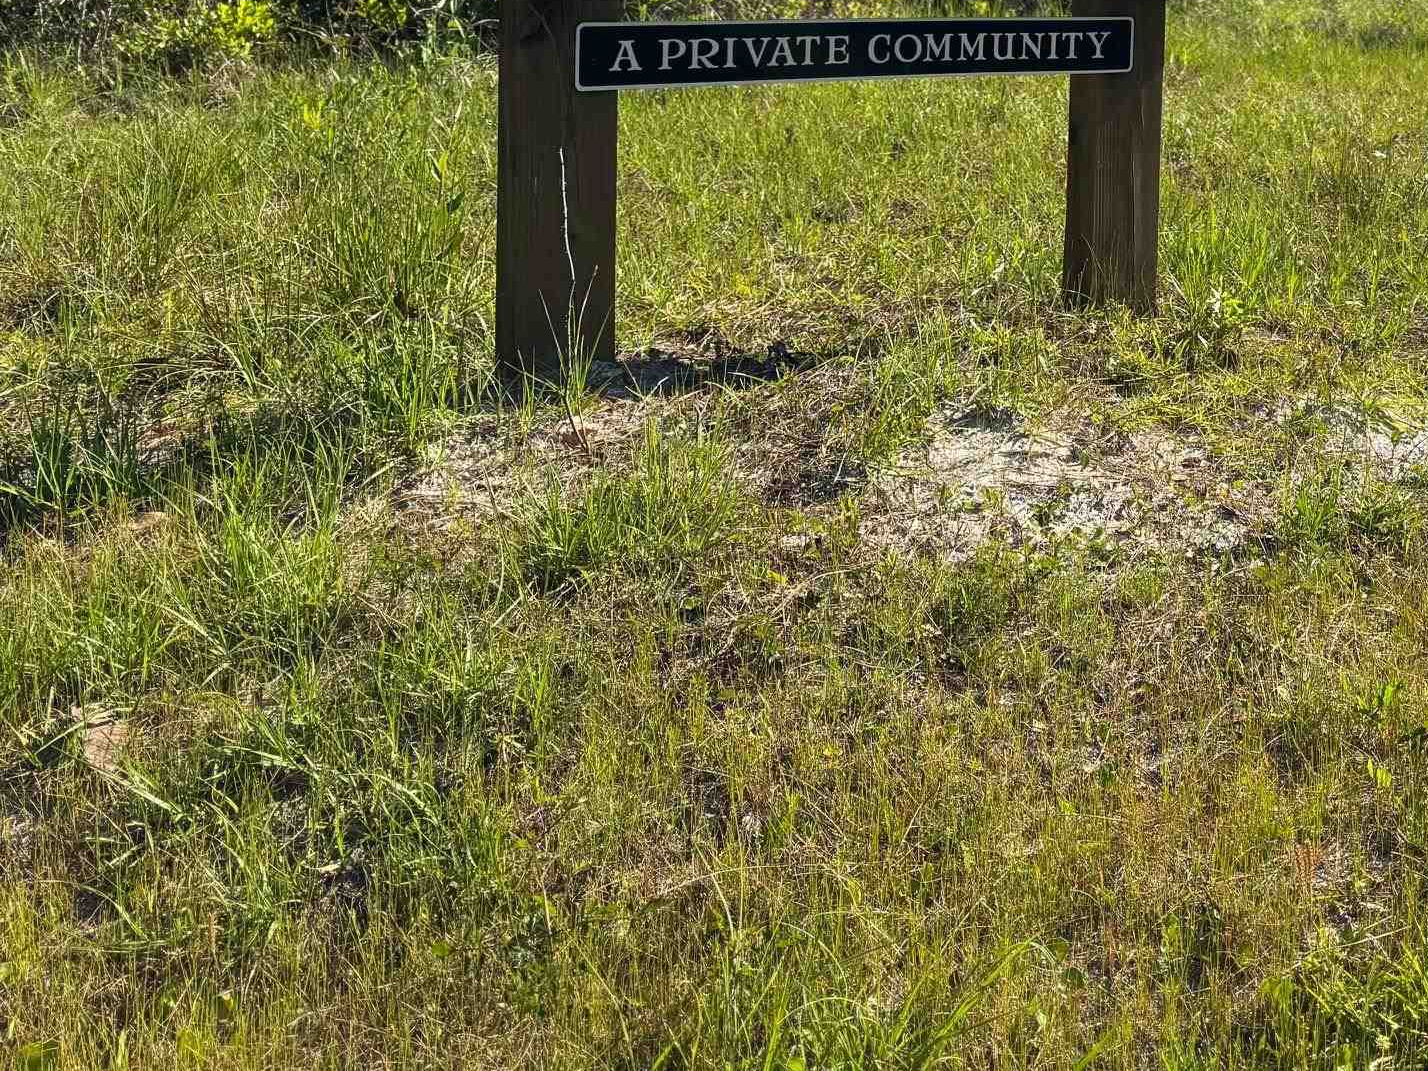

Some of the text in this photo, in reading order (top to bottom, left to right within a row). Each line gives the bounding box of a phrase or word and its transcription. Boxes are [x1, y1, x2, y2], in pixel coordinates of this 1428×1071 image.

[608, 31, 1112, 72] A PRIVATE COMMUNITY
